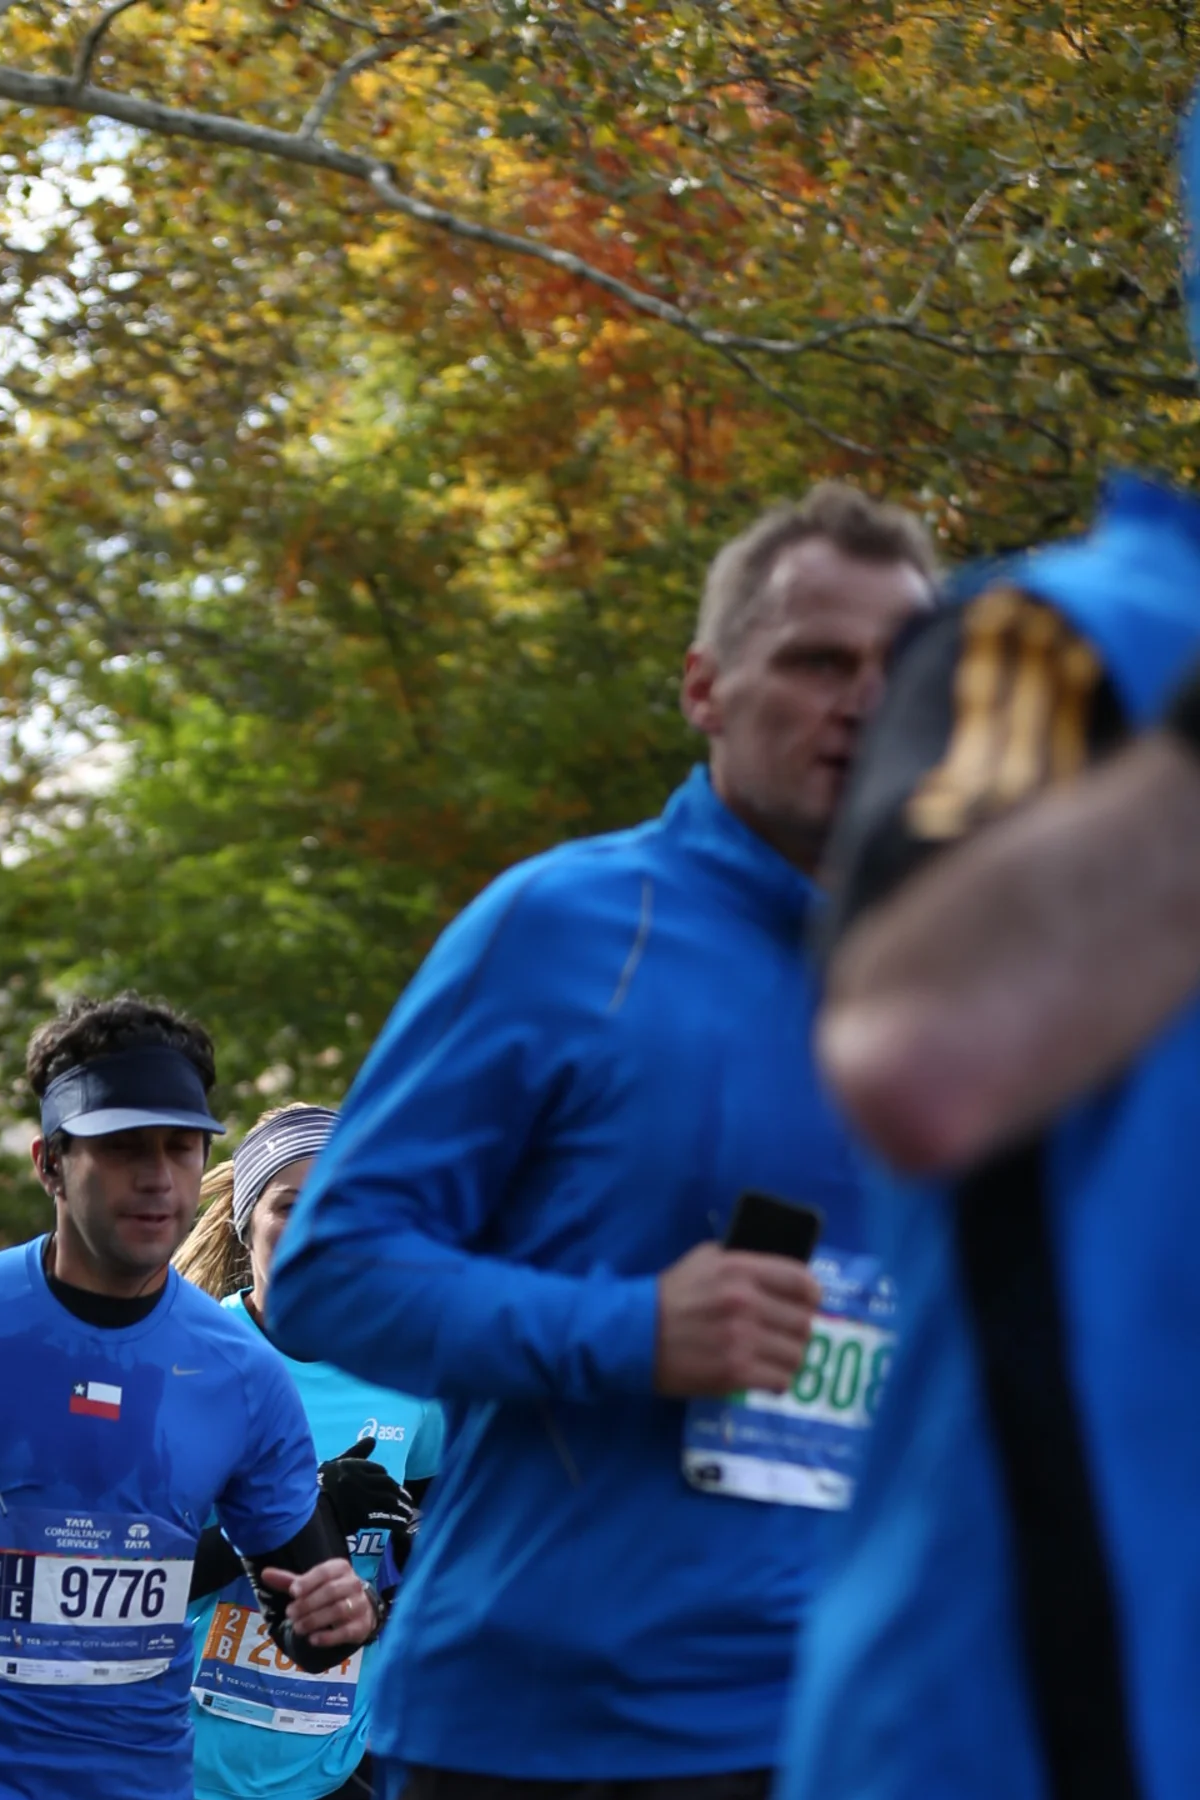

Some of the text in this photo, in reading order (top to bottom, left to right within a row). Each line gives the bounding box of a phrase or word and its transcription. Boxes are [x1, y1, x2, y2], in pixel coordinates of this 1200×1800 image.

[65, 1518, 93, 1528] TATA
[44, 1527, 112, 1540] CONSULTANCY
[56, 1538, 100, 1549] SERVICES
[124, 1540, 150, 1549] TATA
[346, 1534, 386, 1554] SIL
[60, 1565, 168, 1619] 9776
[10, 1591, 25, 1618] E
[224, 1608, 241, 1633] 2
[216, 1635, 233, 1660] B
